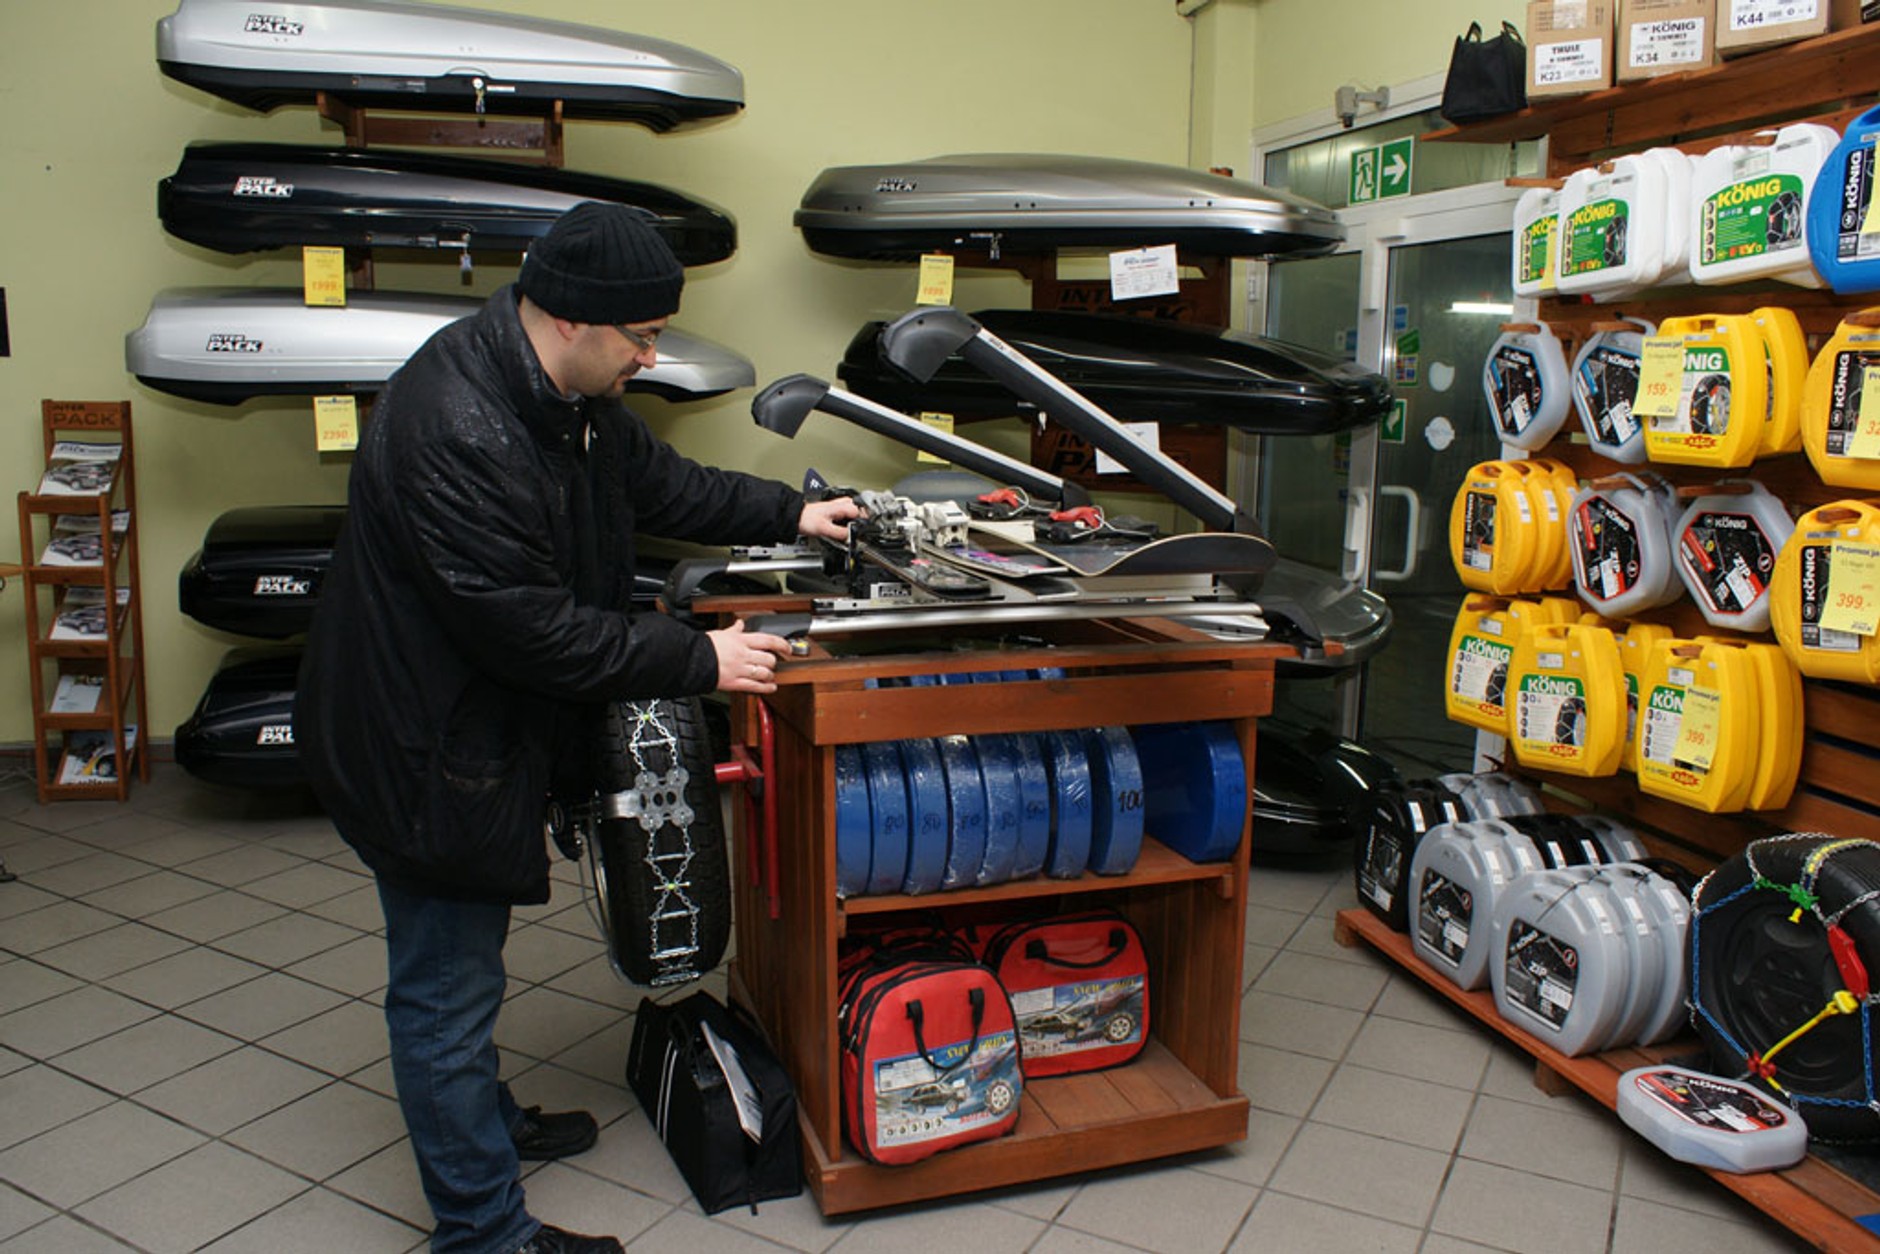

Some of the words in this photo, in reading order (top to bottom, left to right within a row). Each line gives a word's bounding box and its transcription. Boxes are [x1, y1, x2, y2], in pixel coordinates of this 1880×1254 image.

[1652, 20, 1696, 33] KÖNIG
[1736, 12, 1764, 26] K44
[246, 21, 301, 35] PACK
[1636, 52, 1658, 63] K34
[1844, 150, 1862, 209] KÖNIG
[236, 184, 291, 196] PACK
[1717, 178, 1782, 208] KÖNIG
[1573, 201, 1617, 226] KÖNIG
[207, 341, 259, 352] PACK
[1834, 353, 1851, 408] KÖNIG
[53, 412, 117, 426] PACK
[1714, 515, 1748, 530] KÖNIG
[1803, 548, 1816, 601] KÖNIG
[255, 583, 307, 593] PACK
[1466, 639, 1511, 662] KÖNIG
[1527, 675, 1577, 696] KÖNIG
[1652, 689, 1684, 712] KÖN
[259, 733, 295, 744] PAC
[1529, 960, 1548, 977] ZIP
[1688, 1078, 1739, 1095] KÖNIG
